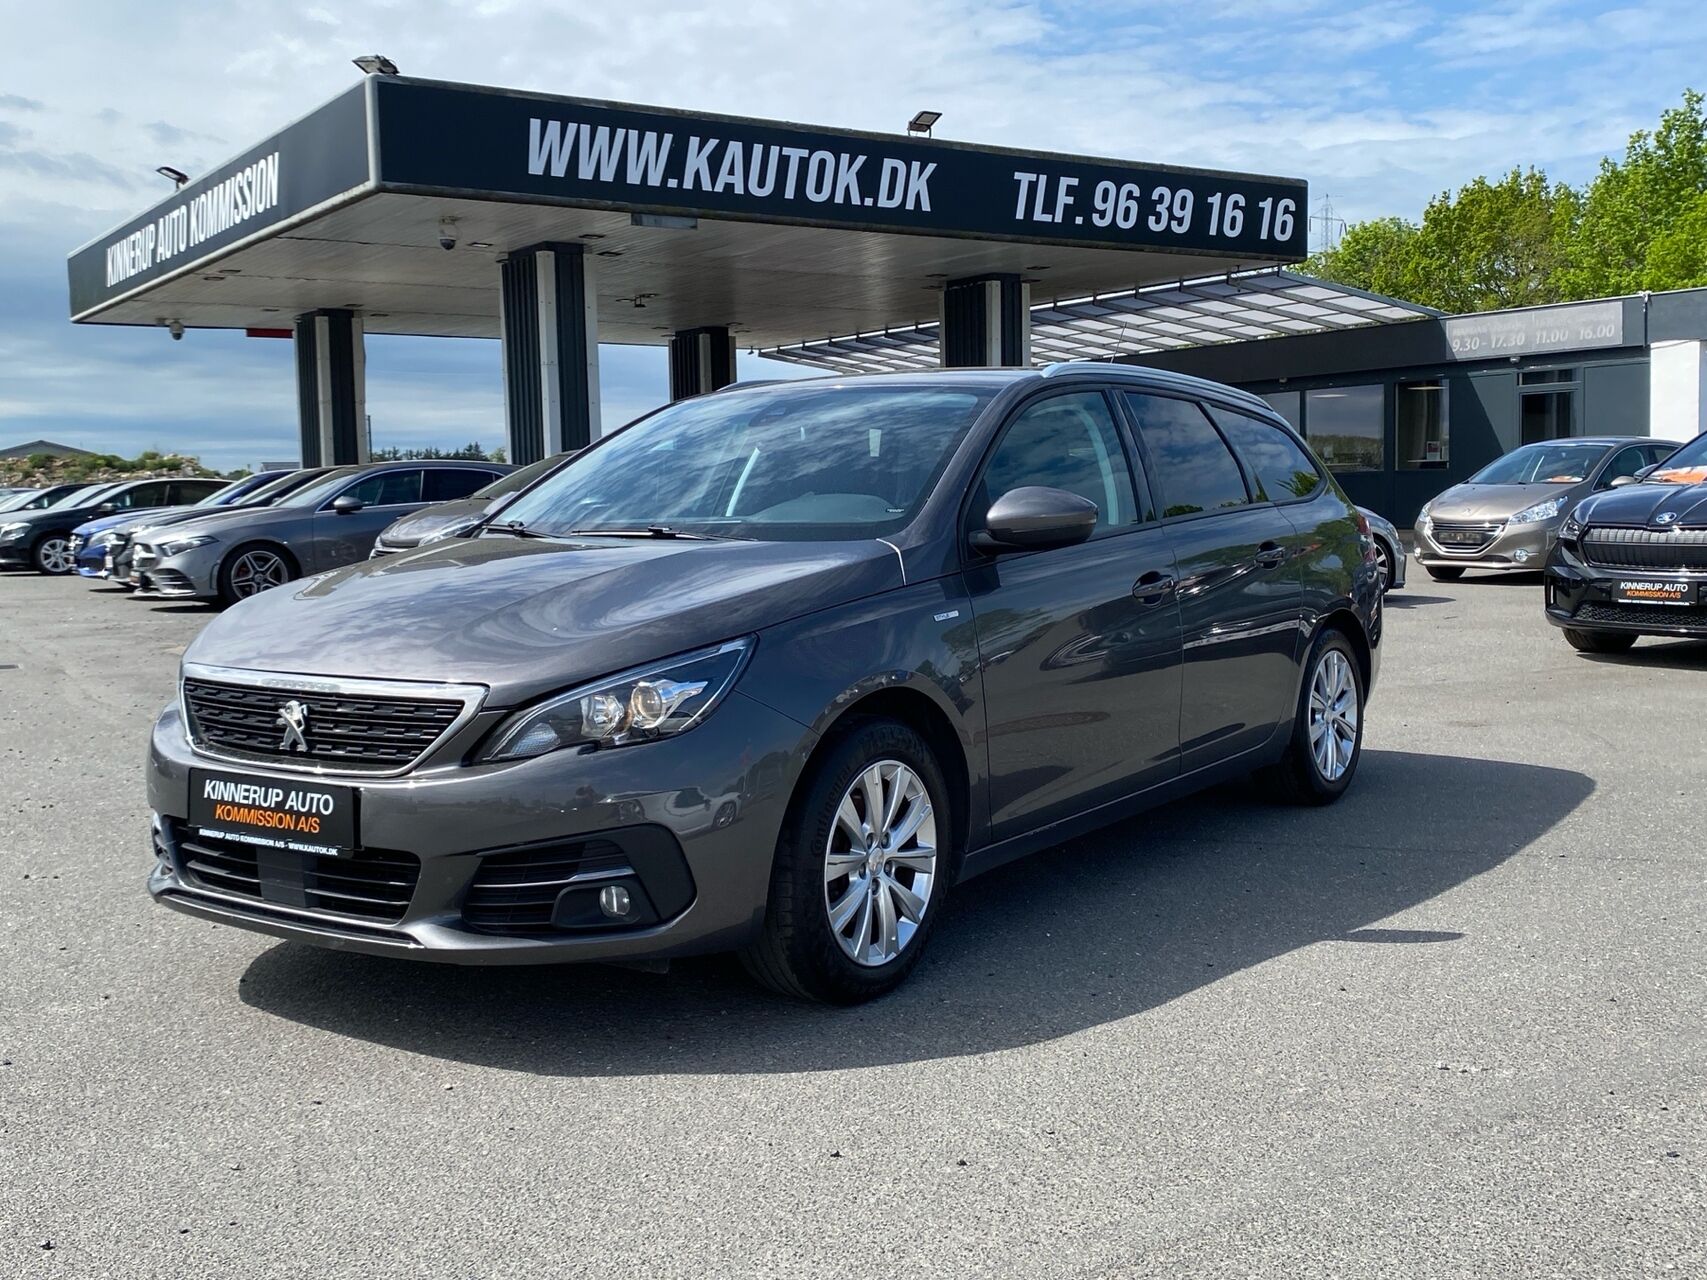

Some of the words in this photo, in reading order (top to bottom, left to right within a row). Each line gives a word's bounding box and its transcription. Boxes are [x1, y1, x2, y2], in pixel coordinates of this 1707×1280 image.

[528, 118, 937, 212] WWW.KAUTOK.DK
[106, 223, 156, 288] KINNERUP
[156, 205, 187, 263] AUTO
[190, 152, 279, 247] KOMMISSION
[1013, 171, 1083, 225] TLF.
[1092, 180, 1141, 229] 96
[1148, 186, 1194, 234] 39
[1207, 192, 1246, 238] 16
[1258, 197, 1296, 242] 16
[1453, 337, 1480, 352] 9.30
[1490, 332, 1525, 348] 17.30
[1536, 330, 1568, 344] 11.00
[1579, 324, 1615, 341] 16.00
[1620, 581, 1663, 591] KINNERUP
[1663, 584, 1688, 592] AUTO
[1626, 590, 1669, 598] KOMMISSION
[203, 779, 283, 808] KINNERUP
[285, 791, 334, 815] AUTO
[215, 804, 295, 829] KOMMISSION
[297, 816, 320, 834] A/S
[199, 828, 225, 839] KINNERUP
[225, 833, 240, 842] AUTO
[240, 834, 274, 847] KOMMISSION
[275, 839, 285, 848] A/S
[288, 842, 339, 856] WWW.KAUTOK.DK
